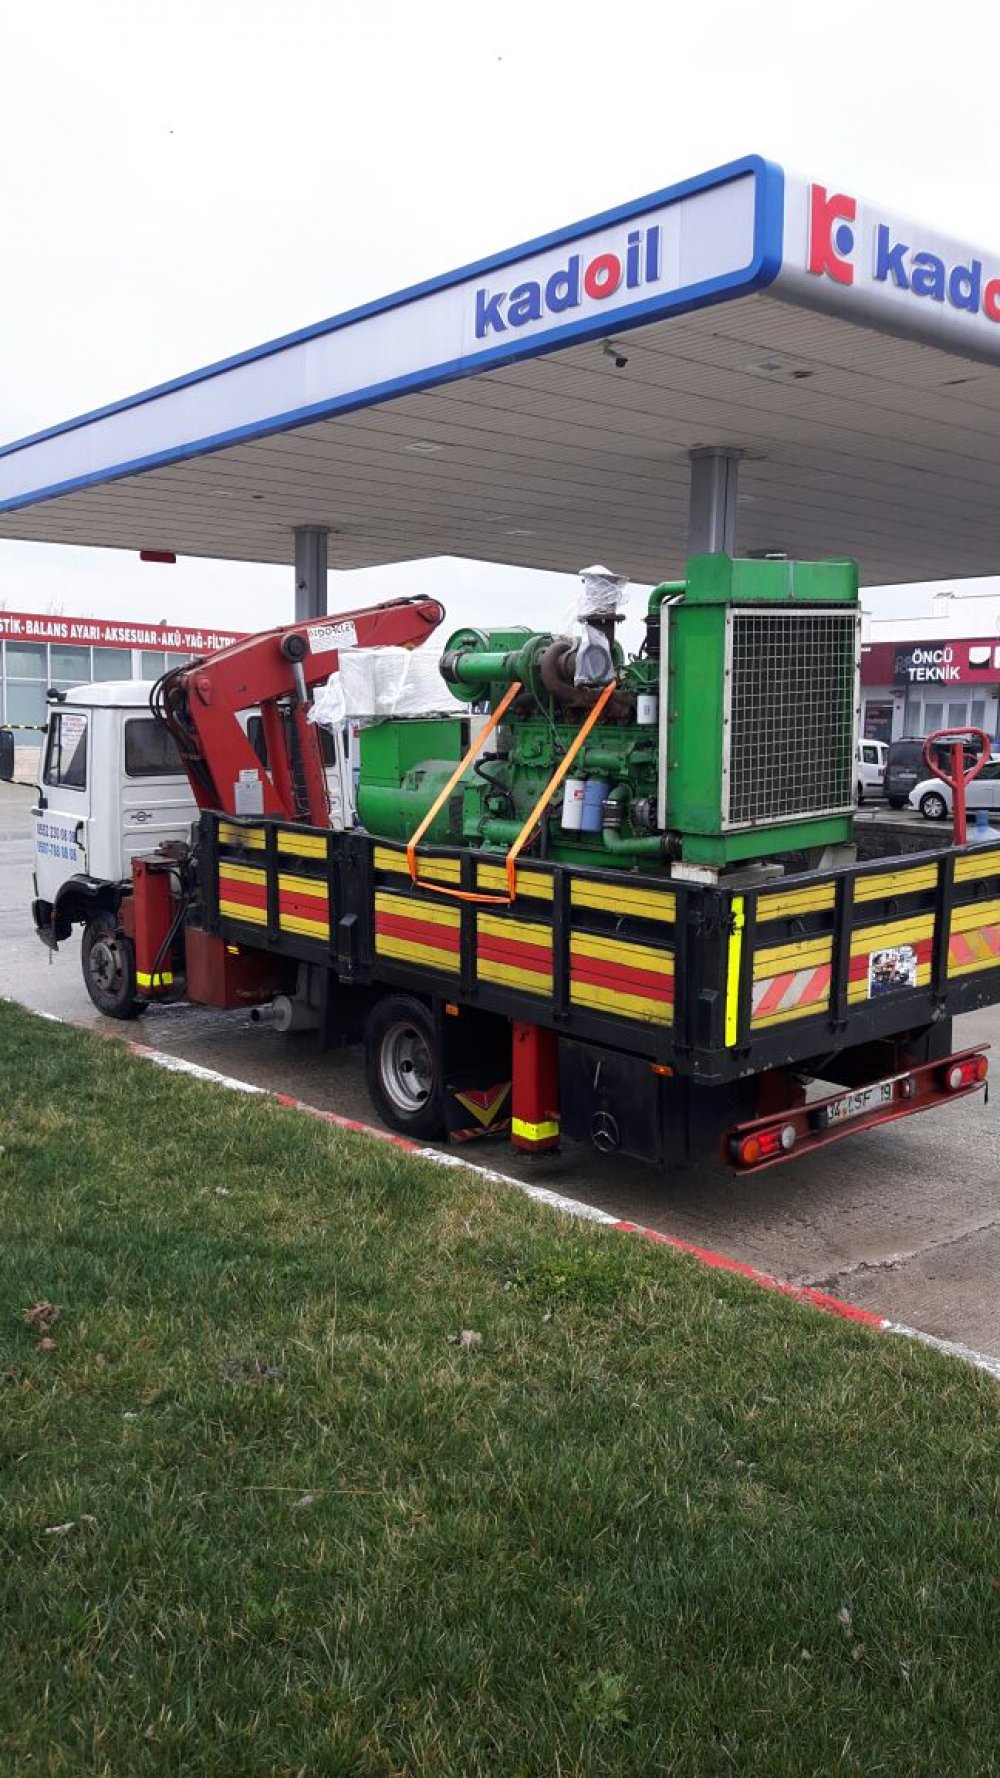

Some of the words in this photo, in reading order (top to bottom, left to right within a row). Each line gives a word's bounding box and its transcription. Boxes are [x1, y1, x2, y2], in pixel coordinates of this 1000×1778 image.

[475, 224, 661, 339] kadoil
[911, 647, 953, 665] ÖNCÜ
[908, 663, 961, 681] TEKNİK
[880, 1083, 891, 1102] 19
